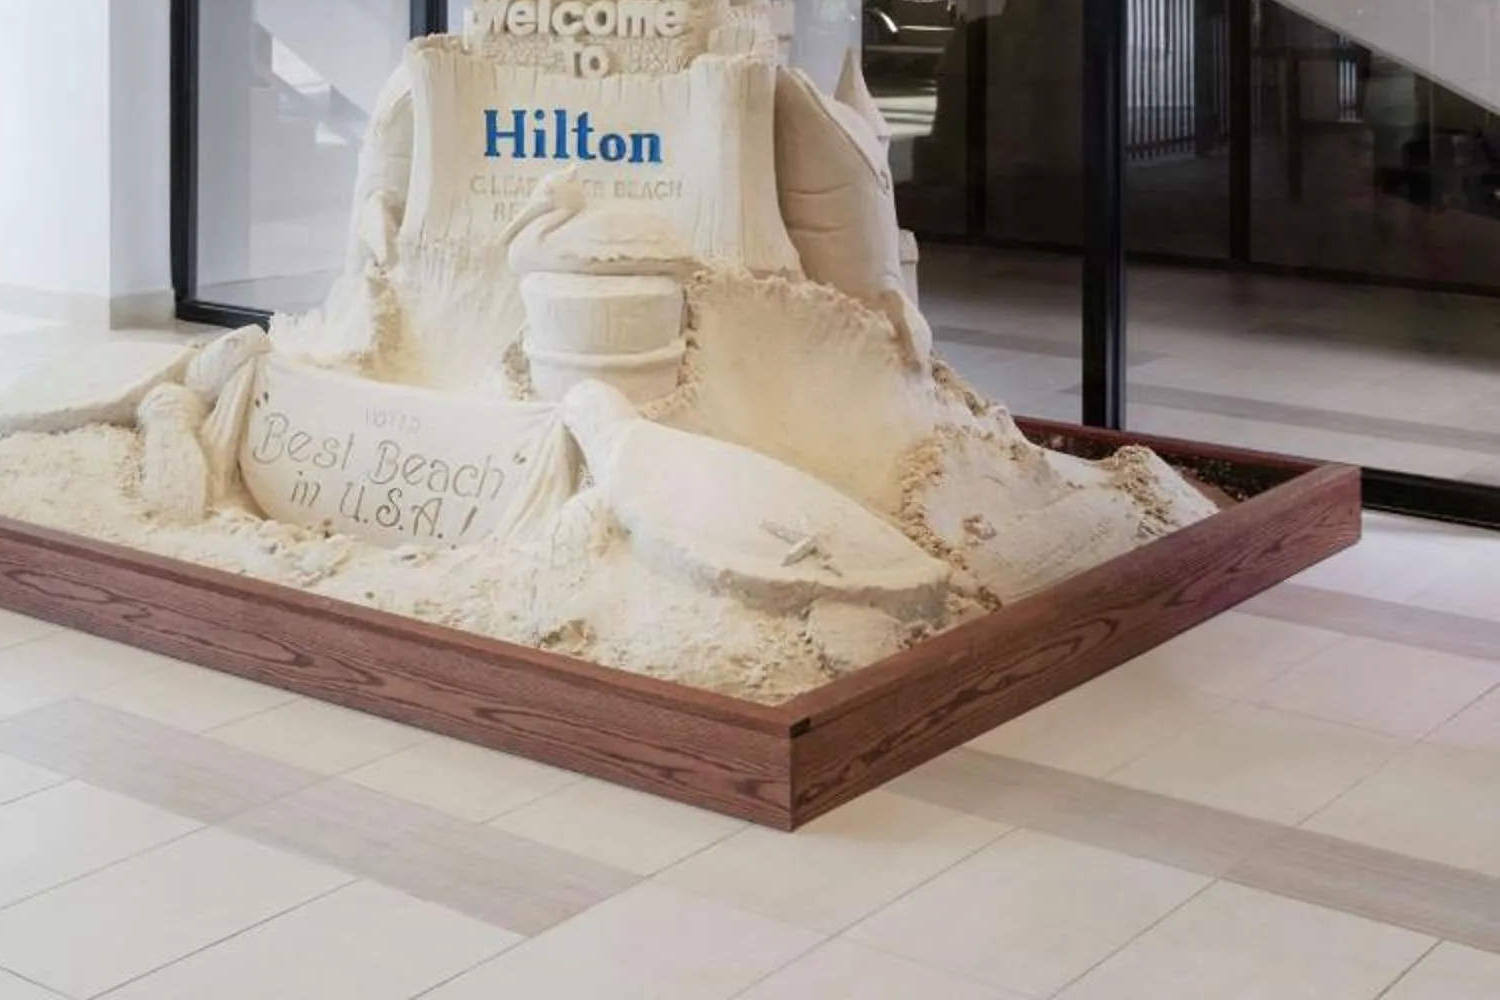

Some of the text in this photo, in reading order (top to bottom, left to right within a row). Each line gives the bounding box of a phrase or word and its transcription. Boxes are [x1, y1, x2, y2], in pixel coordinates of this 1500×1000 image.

[483, 109, 662, 163] Hilton
[614, 178, 683, 201] BEACH
[290, 470, 322, 508] in
